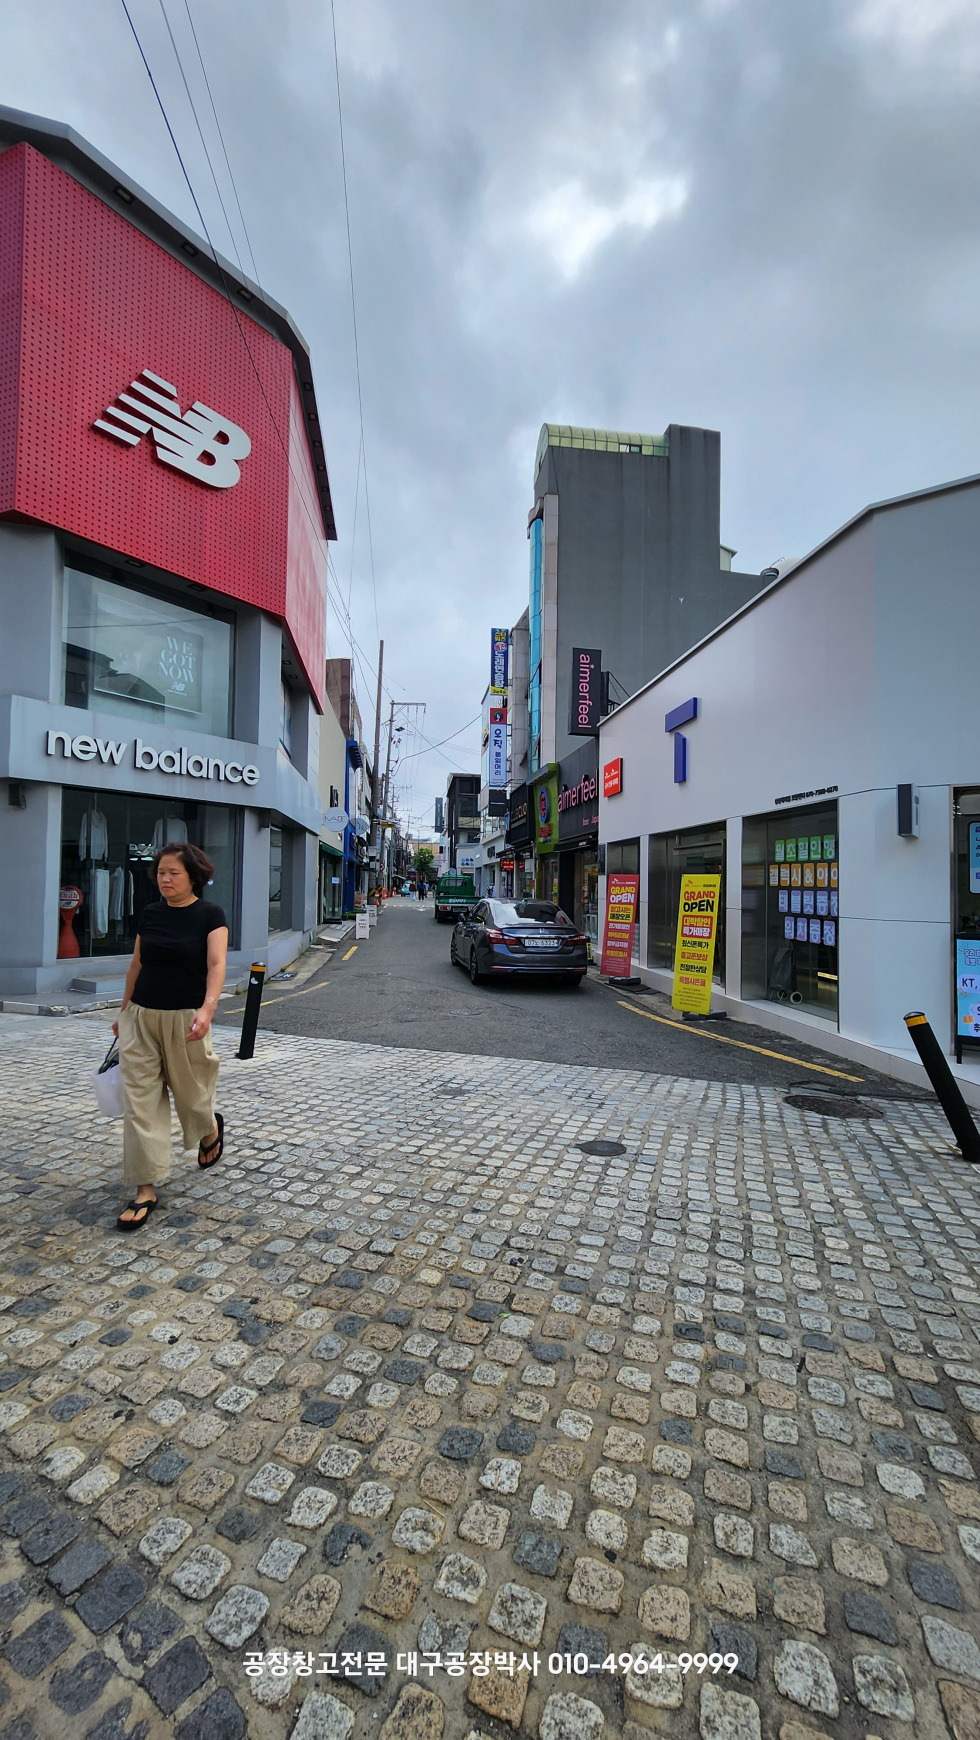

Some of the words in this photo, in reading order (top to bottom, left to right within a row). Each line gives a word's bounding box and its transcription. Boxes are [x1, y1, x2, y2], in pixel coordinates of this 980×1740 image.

[92, 368, 252, 489] NB
[167, 635, 193, 656] WE
[161, 649, 196, 669] GOT
[159, 661, 197, 683] NOW
[578, 653, 595, 728] aimerfeel
[46, 730, 128, 766] new
[134, 738, 261, 786] balance
[557, 768, 598, 813] aimerfeel
[776, 839, 835, 860] 월초할인행
[610, 893, 634, 903] OPEN
[611, 887, 635, 895] GRAND
[684, 891, 715, 901] GRAND
[683, 899, 714, 912] OPEN
[684, 917, 710, 926] 대박할인
[683, 927, 710, 937] 특가매장
[784, 919, 835, 945] 워치증정
[682, 940, 709, 949] 최신폰특가
[680, 964, 707, 973] 친절한상담
